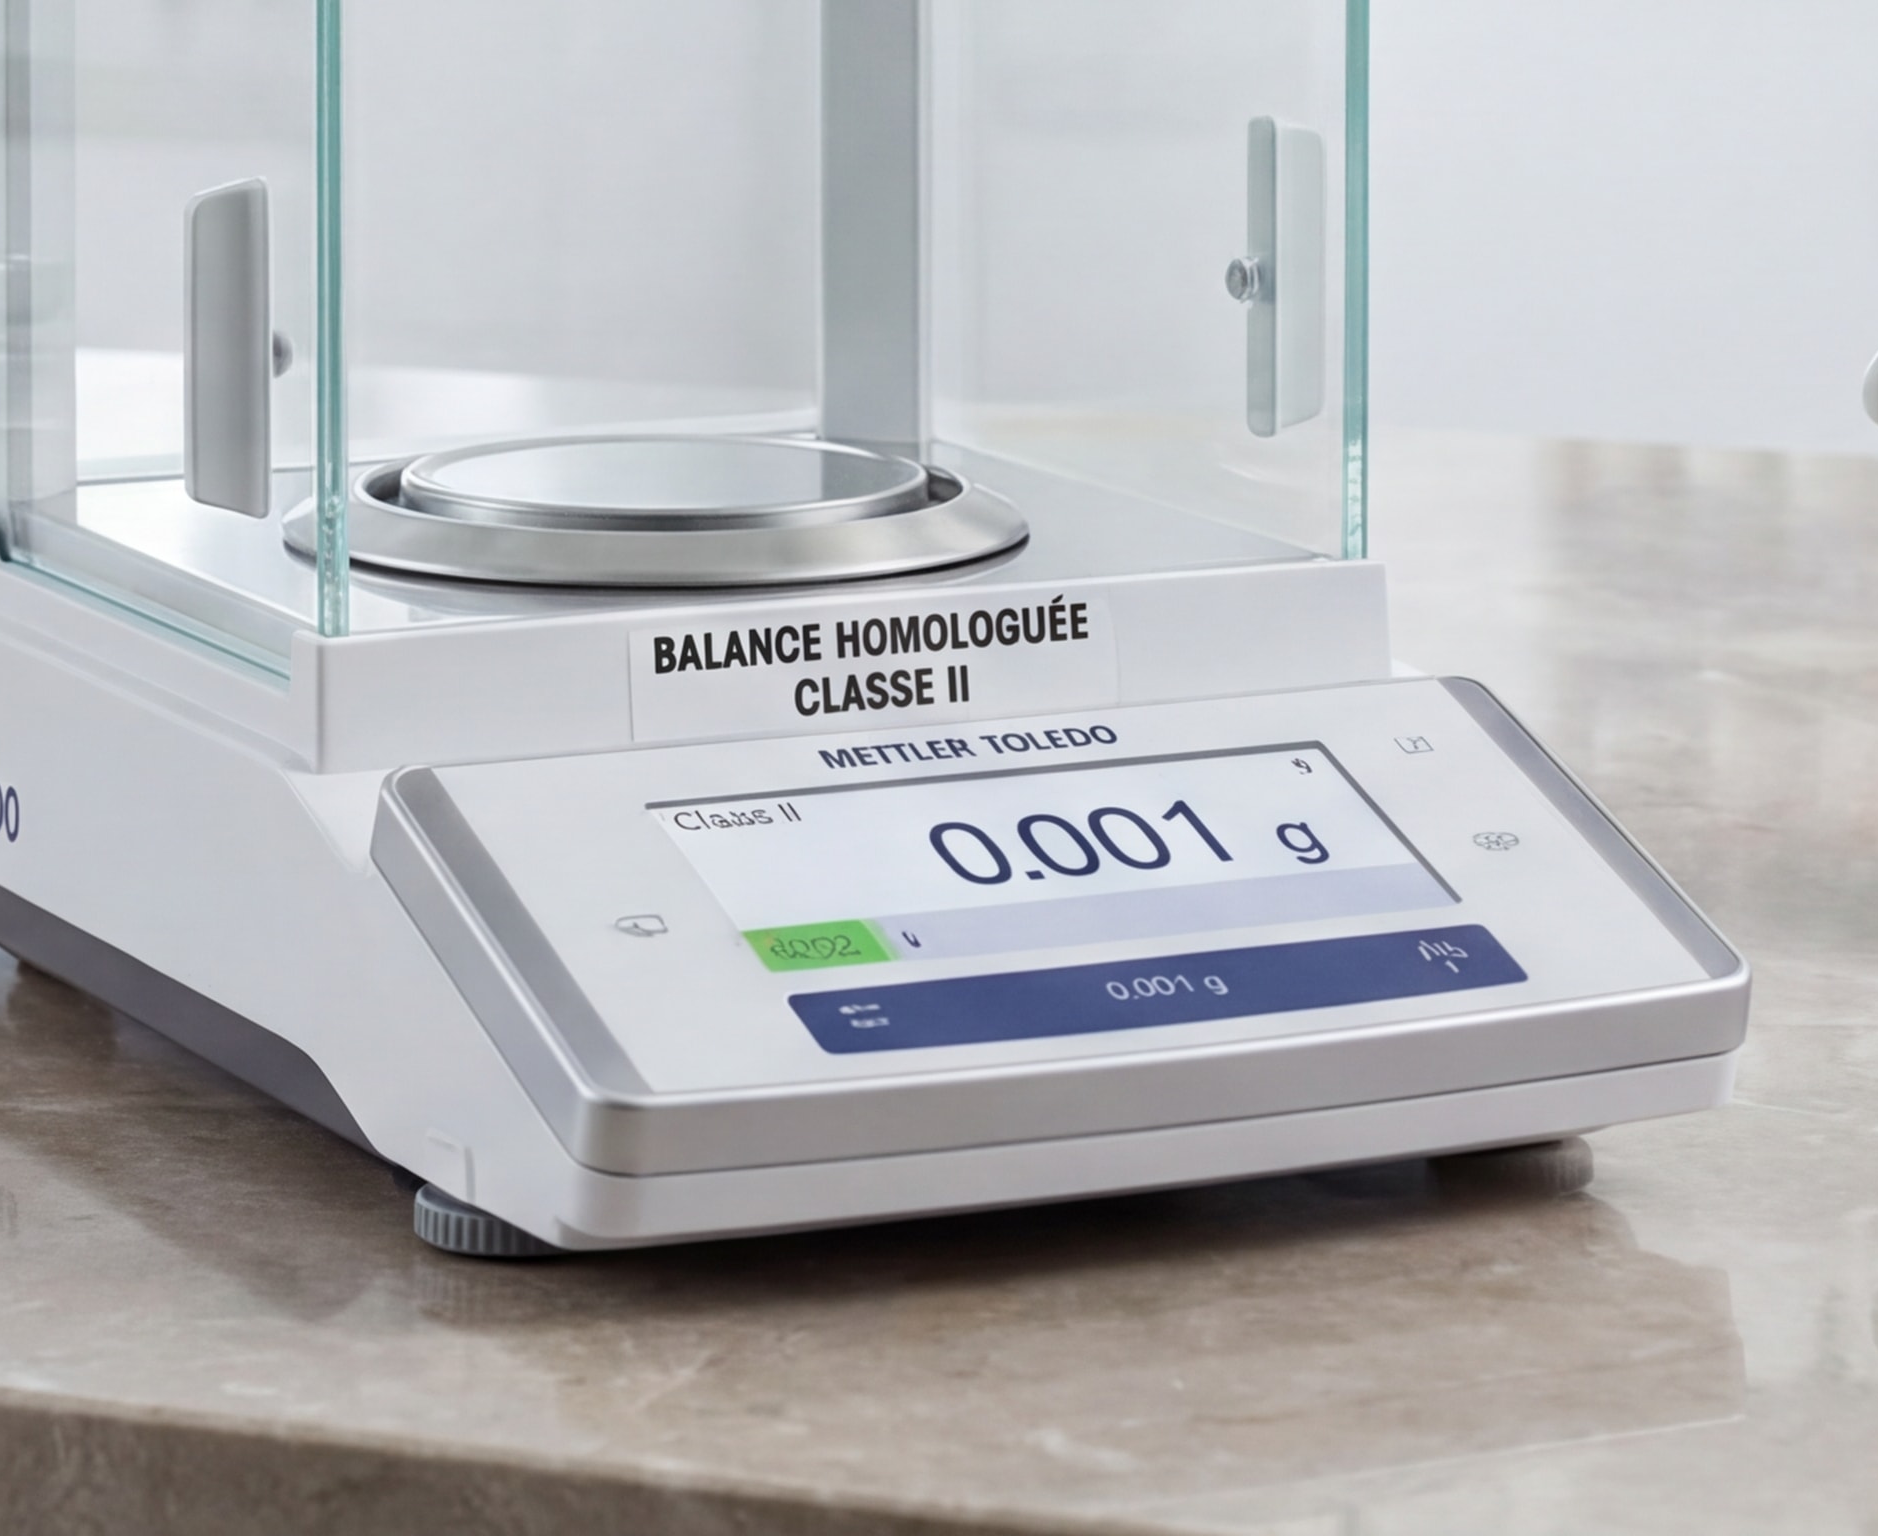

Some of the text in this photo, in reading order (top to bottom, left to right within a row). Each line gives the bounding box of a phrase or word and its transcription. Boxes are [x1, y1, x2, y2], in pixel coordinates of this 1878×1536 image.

[654, 594, 1089, 674] BALANCE HOMOLOGUÉE
[794, 665, 970, 717] CLASSE II
[818, 724, 1118, 769] METTLER TOLEDO
[928, 799, 1330, 885] 0.001 g
[1106, 974, 1228, 1001] 0.001 g
